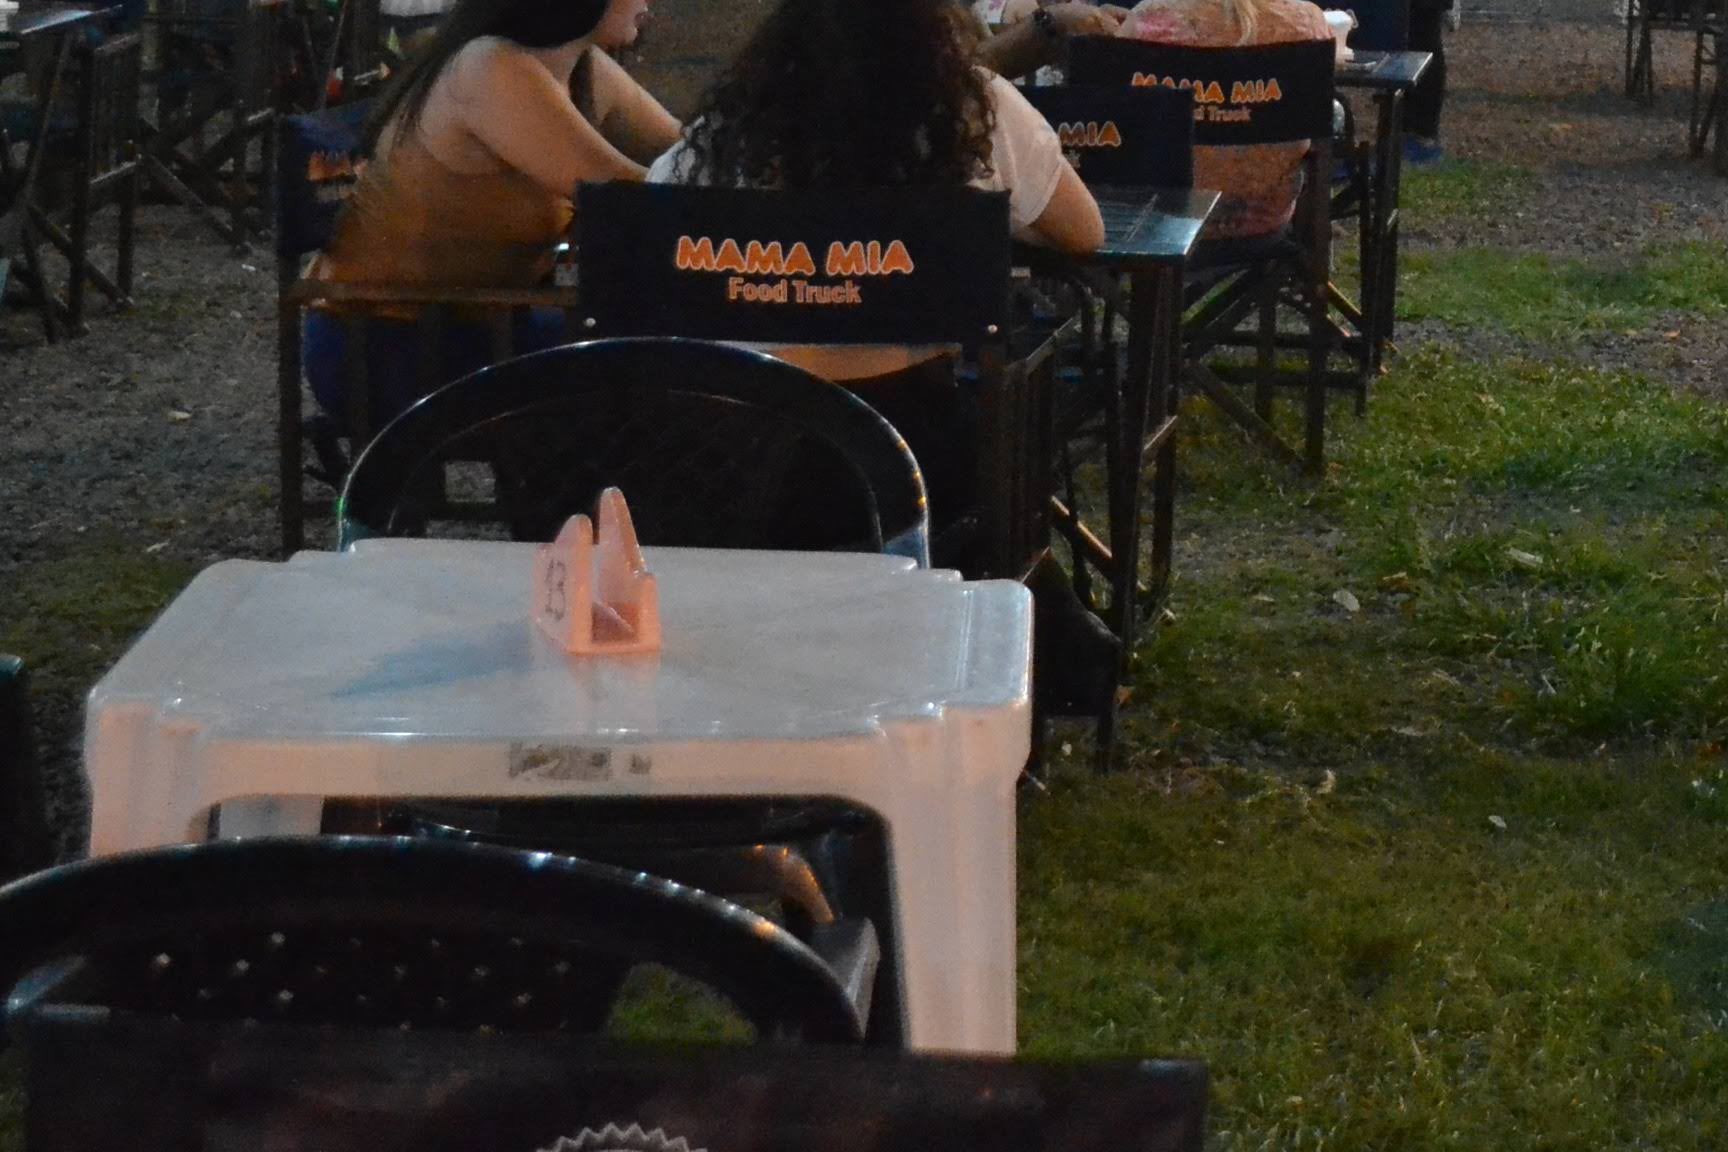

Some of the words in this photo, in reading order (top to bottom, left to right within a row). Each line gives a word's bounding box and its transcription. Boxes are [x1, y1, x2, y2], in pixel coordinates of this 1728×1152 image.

[1230, 77, 1282, 103] MIA
[1057, 120, 1122, 148] MIA
[675, 235, 817, 277] MAMA
[825, 239, 916, 277] MIA
[728, 276, 788, 304] Food
[791, 279, 863, 305] Truck
